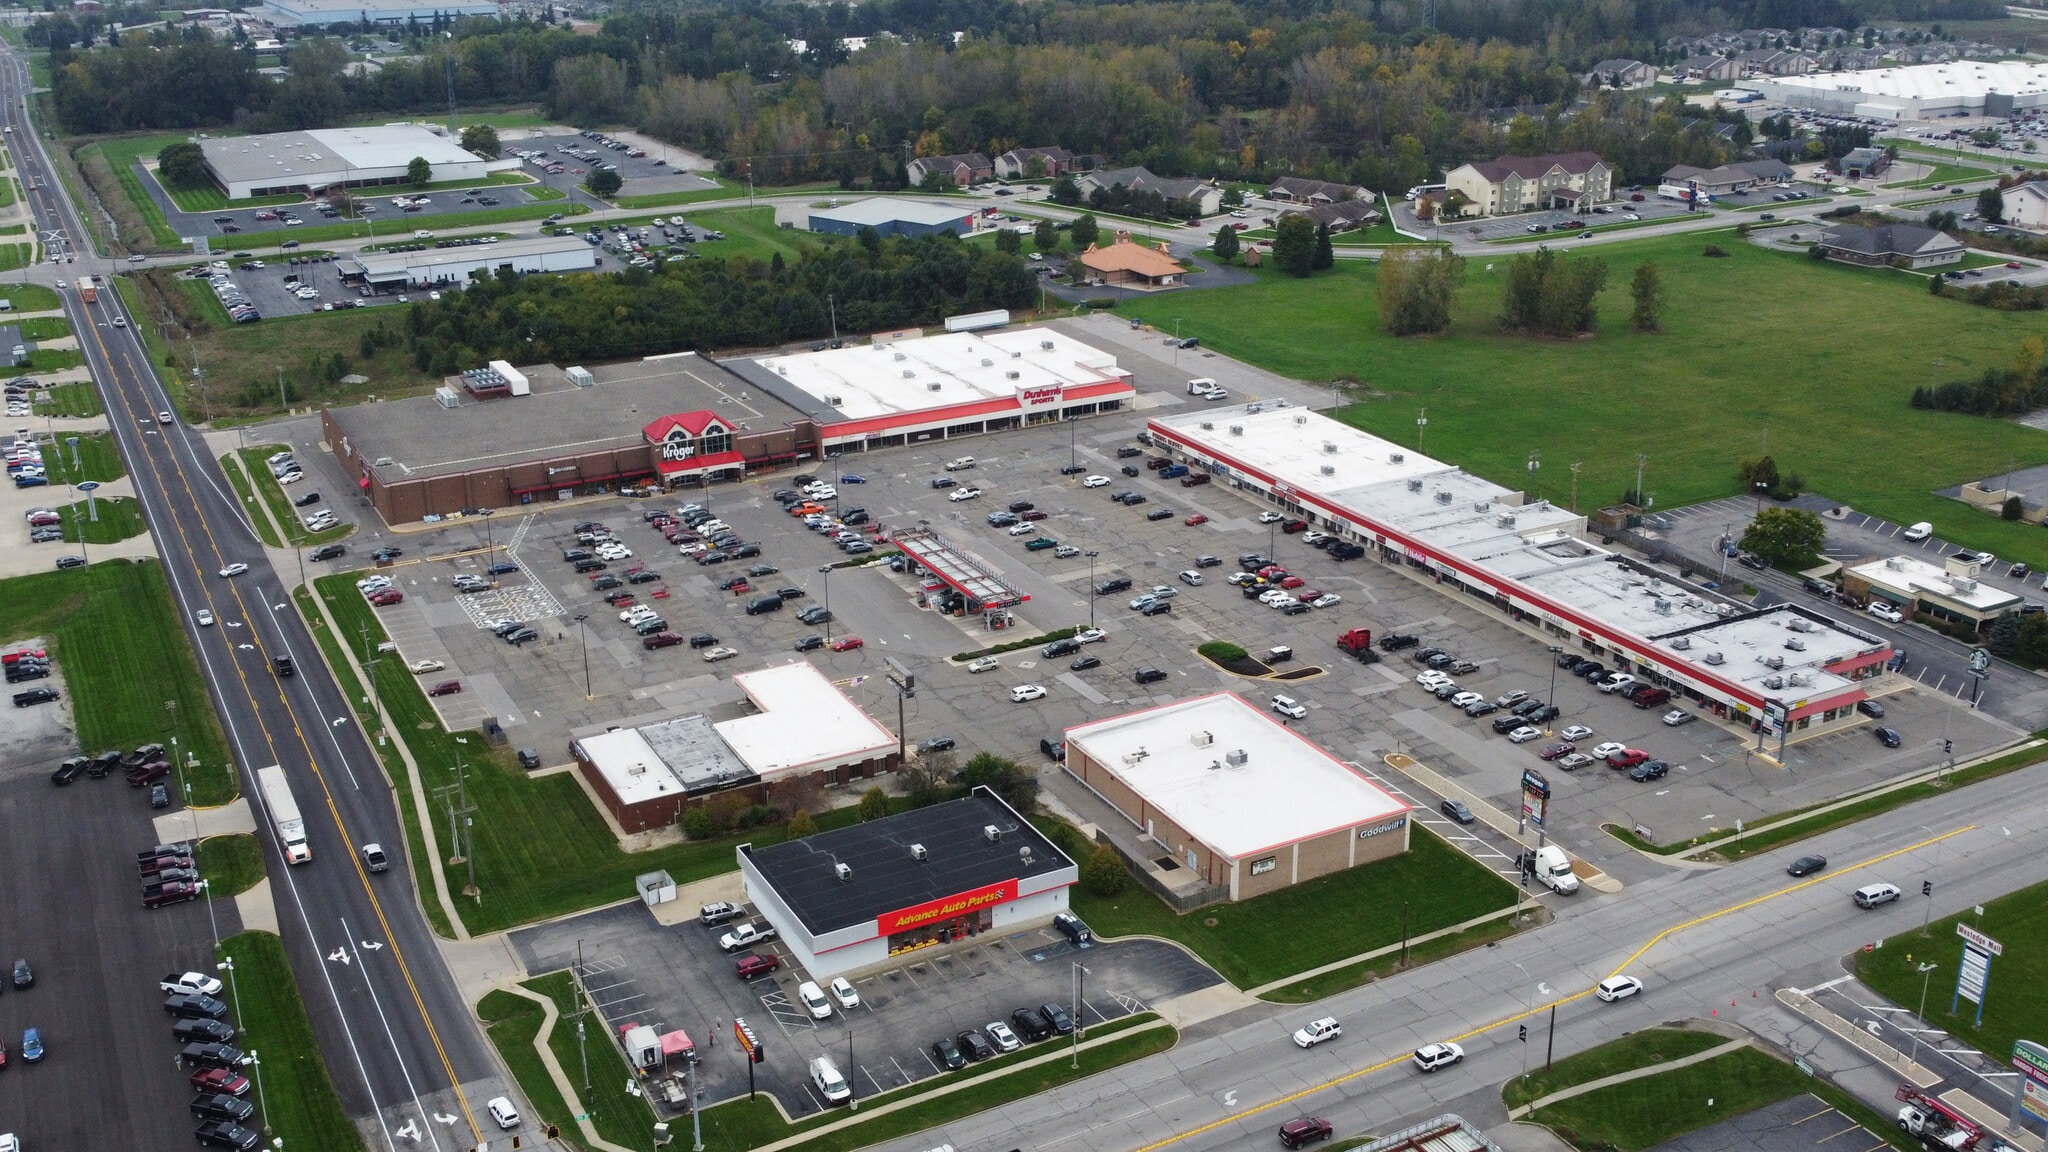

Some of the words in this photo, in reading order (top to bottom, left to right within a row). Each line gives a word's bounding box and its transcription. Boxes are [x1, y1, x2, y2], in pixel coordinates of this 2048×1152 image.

[1023, 386, 1061, 400] Dunham's
[663, 443, 694, 460] Kroger
[1359, 819, 1399, 838] Goodwill
[895, 909, 939, 927] Advance
[940, 900, 966, 915] Auto
[967, 891, 995, 908] Parts
[1958, 925, 1986, 946] Westedge
[1988, 940, 2001, 953] Mall
